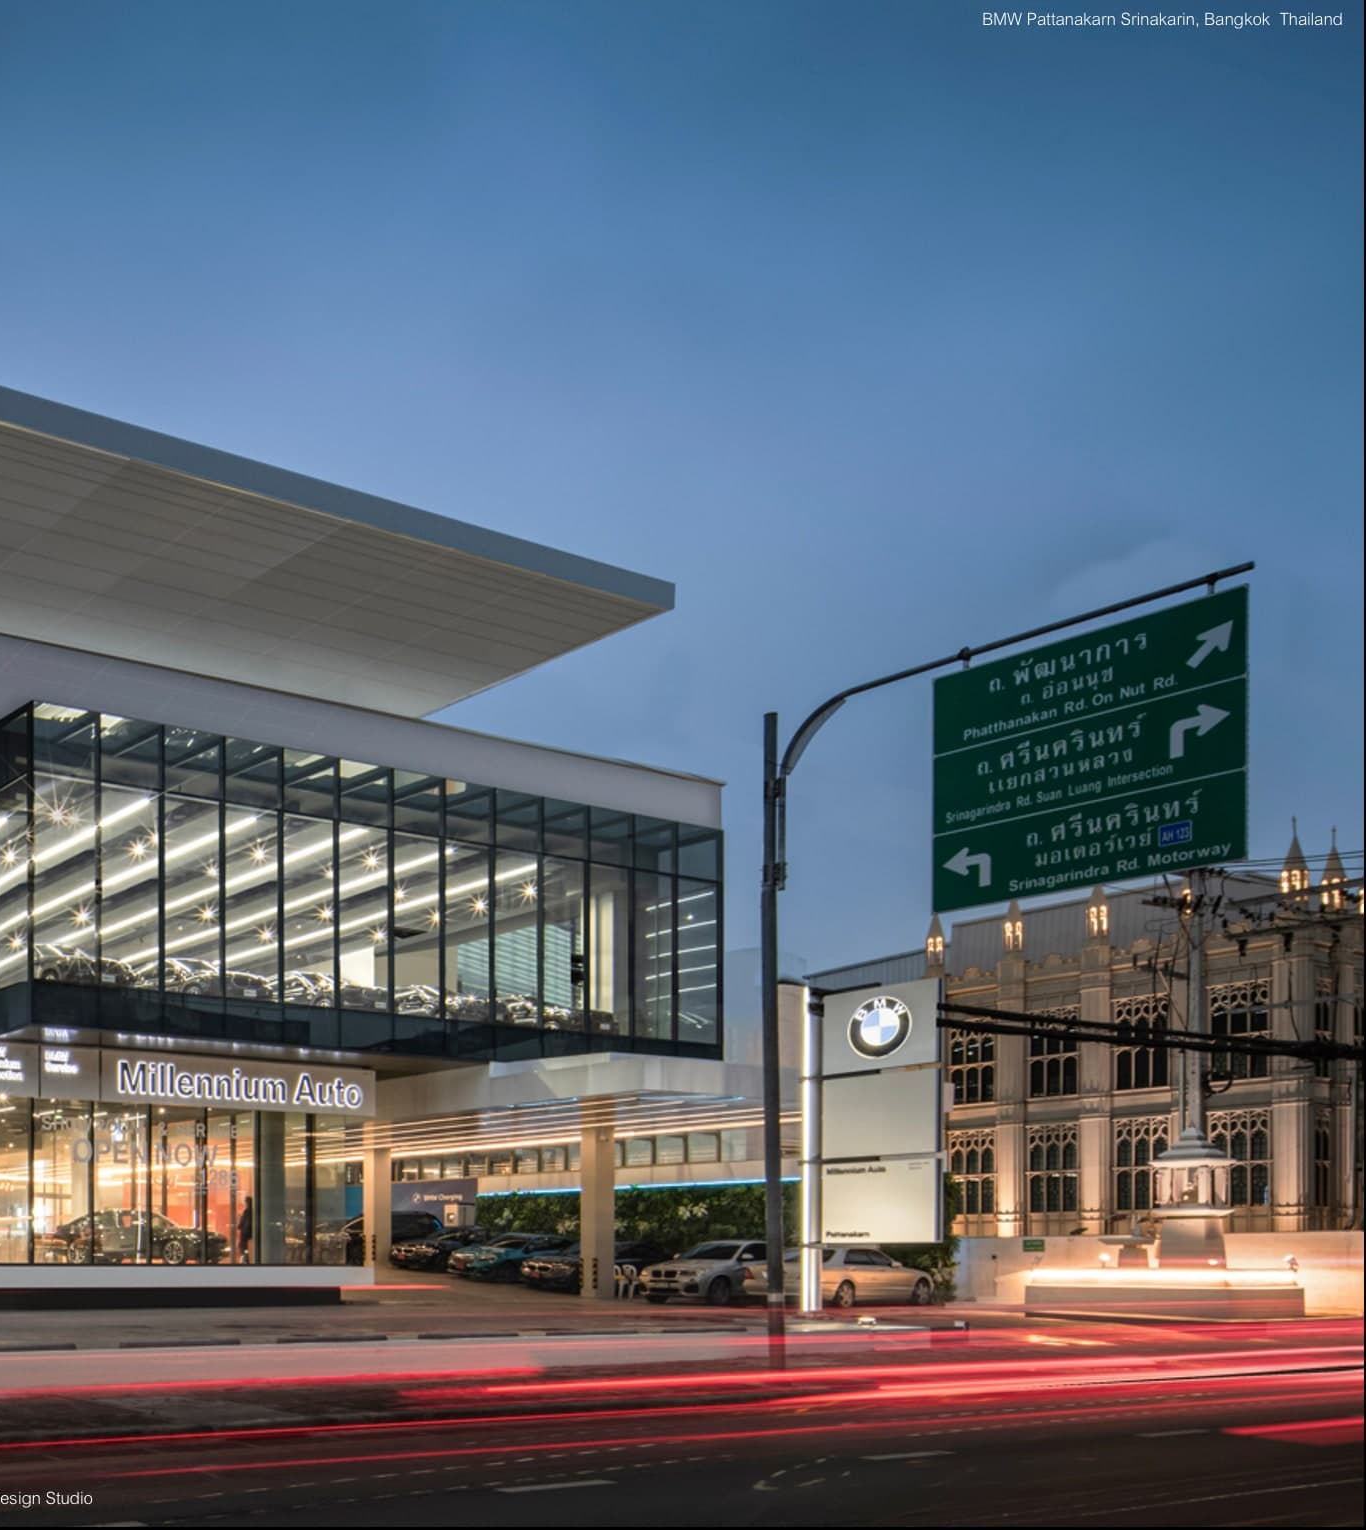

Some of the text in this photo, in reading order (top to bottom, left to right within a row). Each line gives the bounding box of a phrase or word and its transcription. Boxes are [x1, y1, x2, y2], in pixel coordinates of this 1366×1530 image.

[989, 632, 1148, 693] ถ. พัฒนาการ
[1021, 666, 1115, 705] ถ. อ่อนนุช
[963, 673, 1179, 741] Phatthanakan Rd. On Nut Rd.
[977, 712, 1147, 776] ถ. ศรีนครินทร์
[945, 764, 1174, 824] Srinagarindra Rd. Suan Luang Intersection
[989, 748, 1134, 794] แยกสวนหลวง
[1026, 788, 1203, 847] ถ. ศรีนครินทร์
[1161, 830, 1174, 843] AH
[1009, 842, 1232, 893] Srinagarindra Rd. Motorway
[1035, 826, 1155, 867] มอเตอร์เวย์
[117, 1059, 363, 1110] Millennium Auto
[72, 1138, 218, 1168] OPEN NOW
